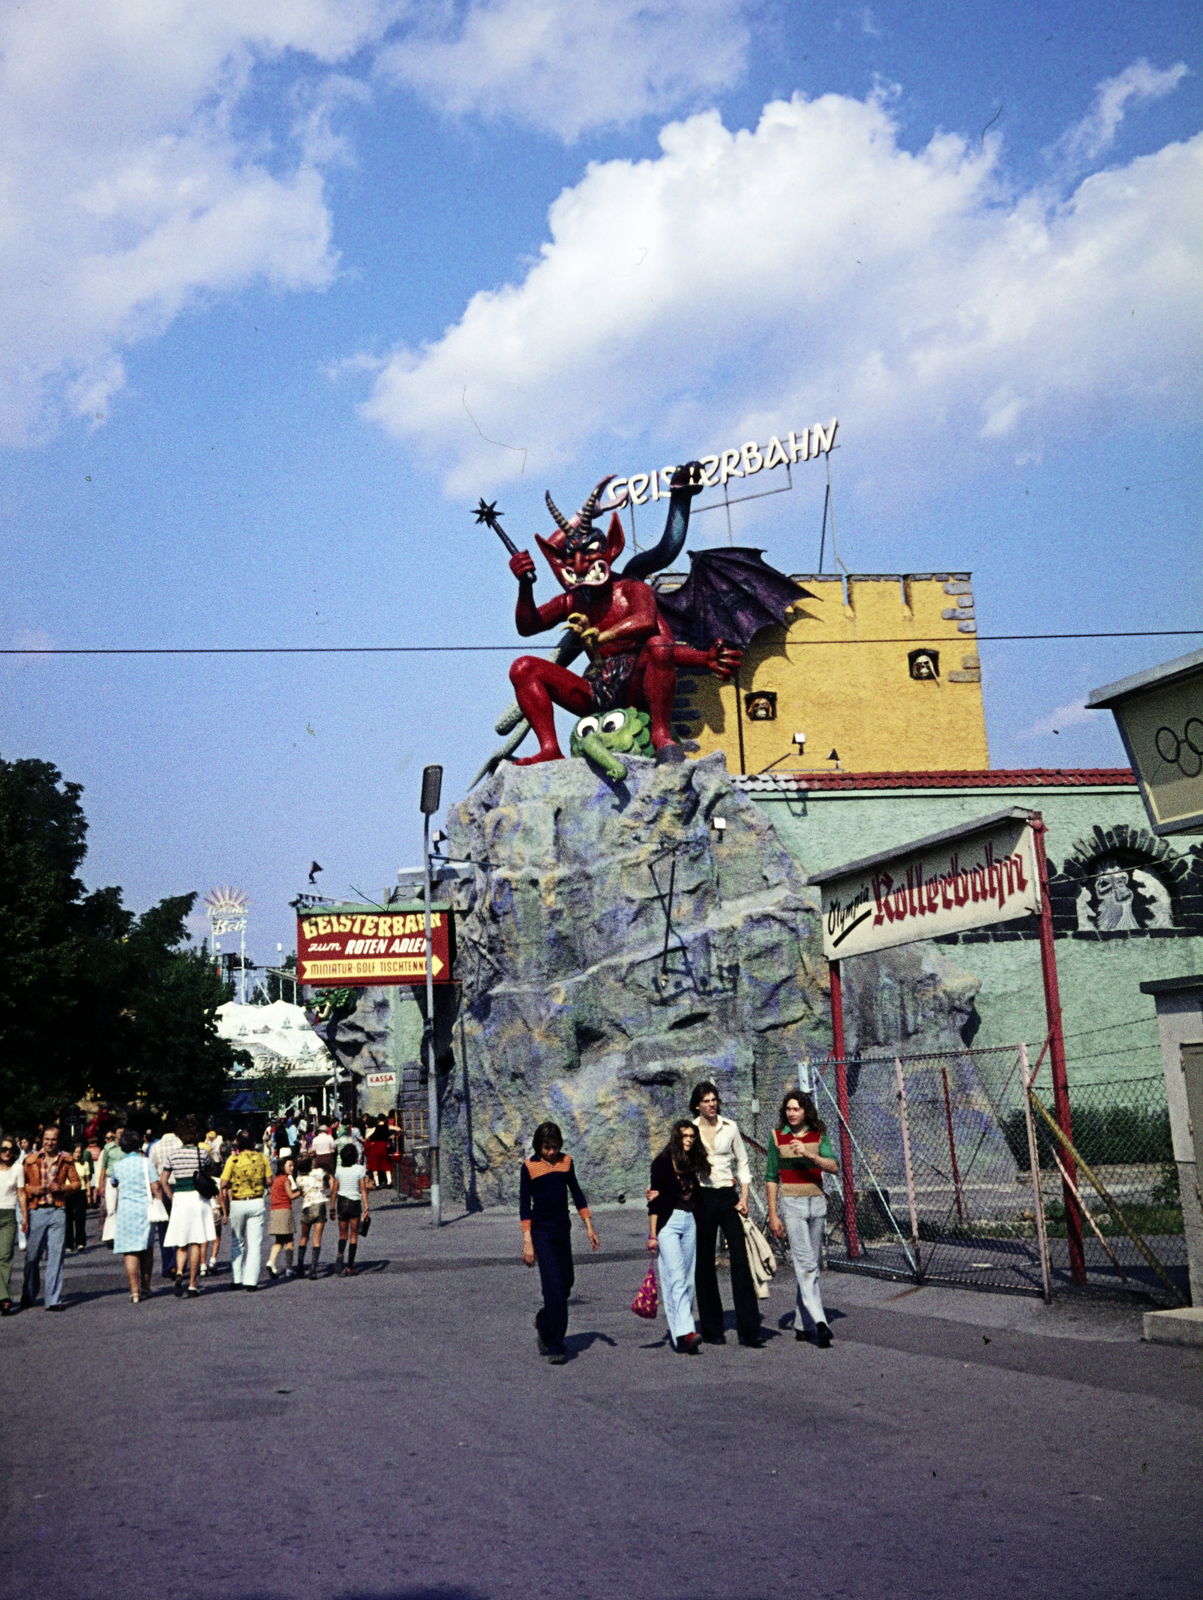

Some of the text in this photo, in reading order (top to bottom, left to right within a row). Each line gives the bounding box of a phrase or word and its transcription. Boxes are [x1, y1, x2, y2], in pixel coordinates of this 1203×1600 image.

[607, 418, 837, 508] GEISERBAHN
[828, 842, 1028, 936] Olympia Rollerbahn
[308, 942, 341, 952] zum
[345, 938, 388, 955] ROTEN
[311, 962, 375, 975] MINIATUR-GOLF
[370, 1075, 393, 1083] KASSA
